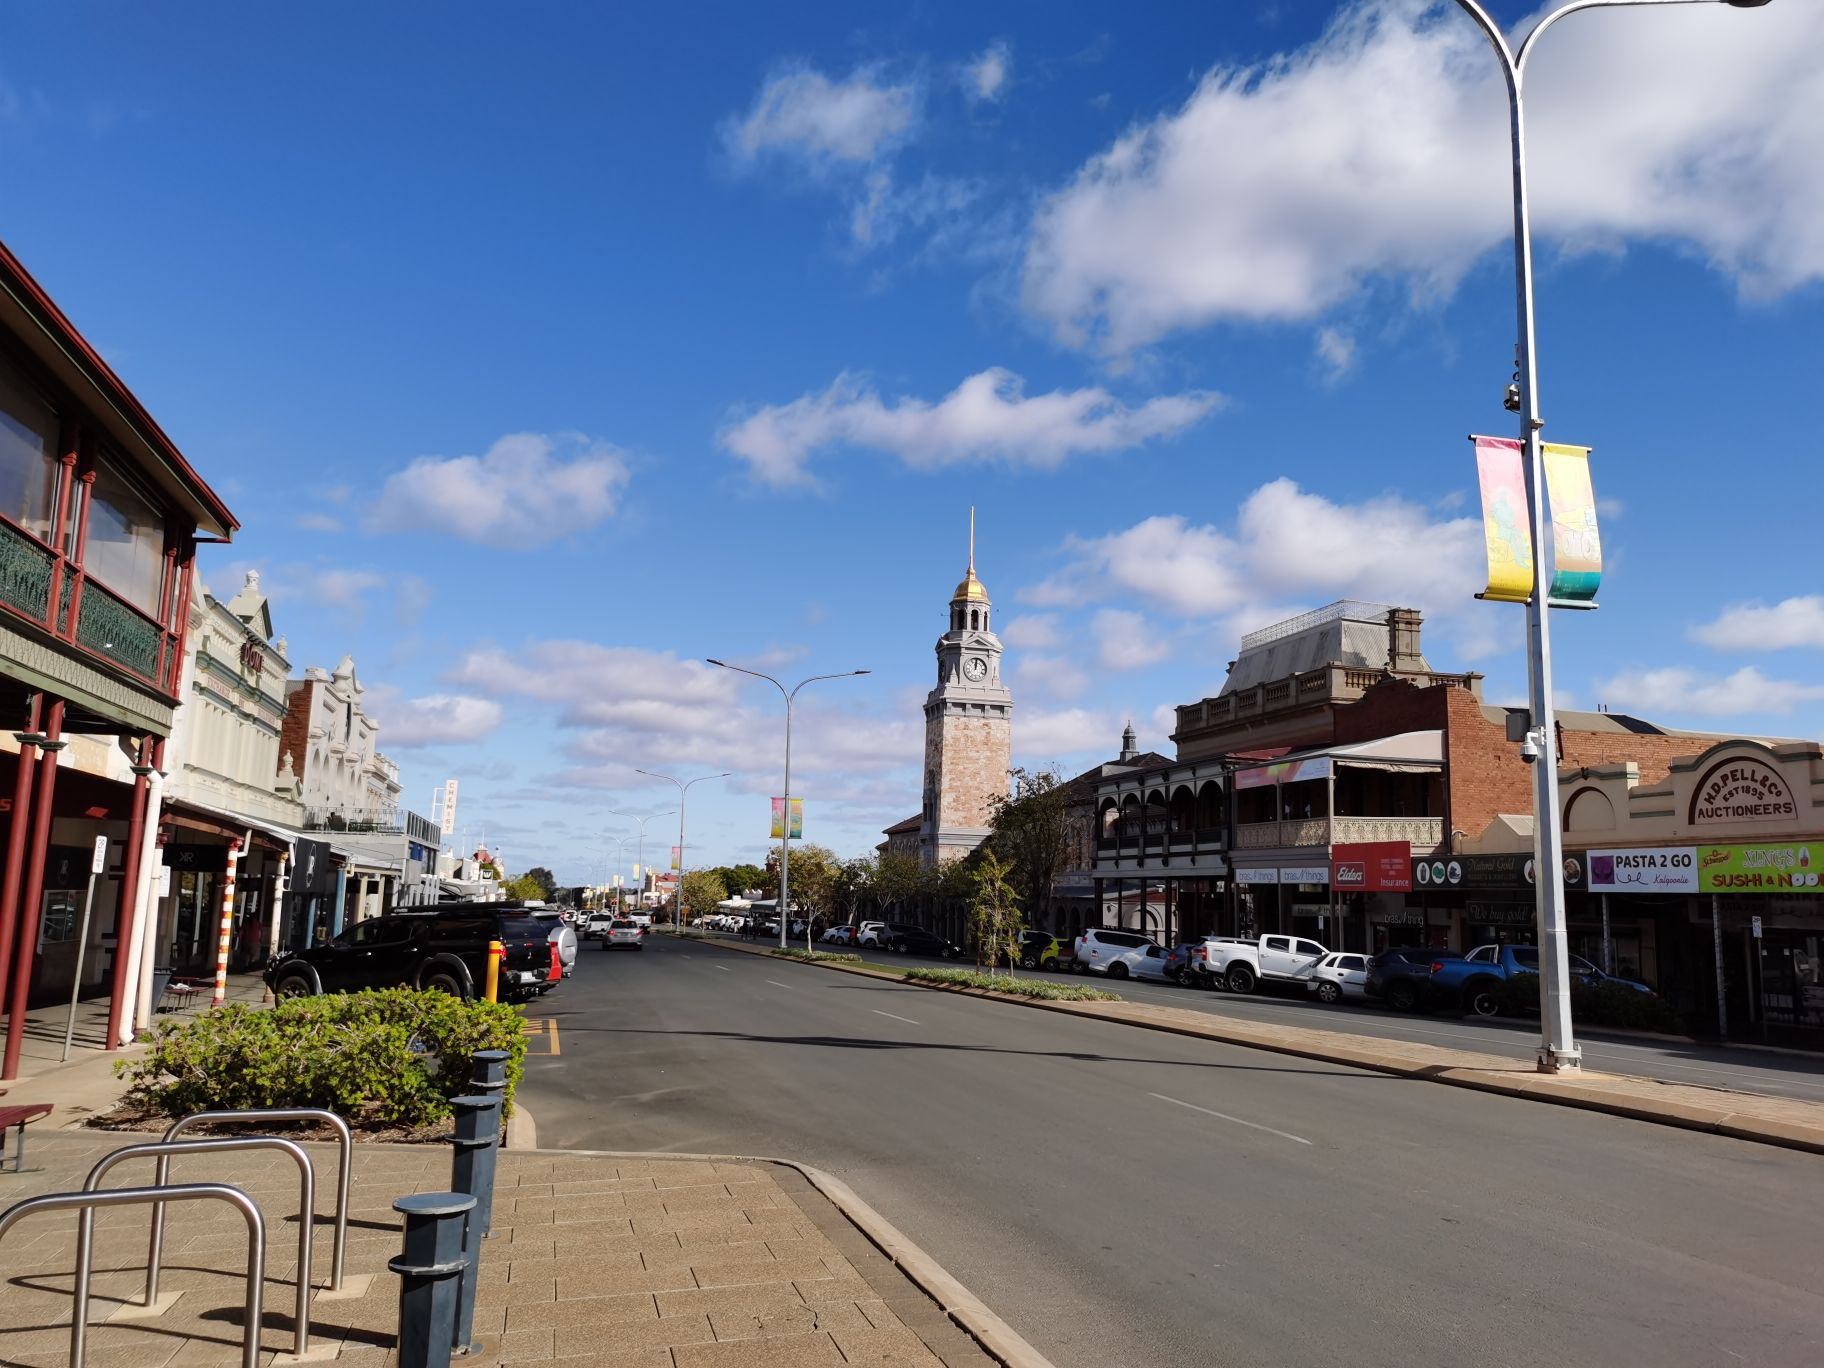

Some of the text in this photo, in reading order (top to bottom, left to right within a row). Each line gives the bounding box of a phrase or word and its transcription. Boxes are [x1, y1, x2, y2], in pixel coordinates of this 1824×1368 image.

[1722, 784, 1765, 803] EST 1895
[445, 782, 455, 831] CHEMIST
[1697, 802, 1793, 819] AUCTIONEERS
[1615, 853, 1692, 869] PASTA 2 GO
[1337, 866, 1363, 881] Elders
[1653, 873, 1689, 887] Kalgoorlie
[1711, 873, 1763, 888] SUSHI
[1765, 875, 1775, 885] &
[1380, 877, 1409, 887] Insurance
